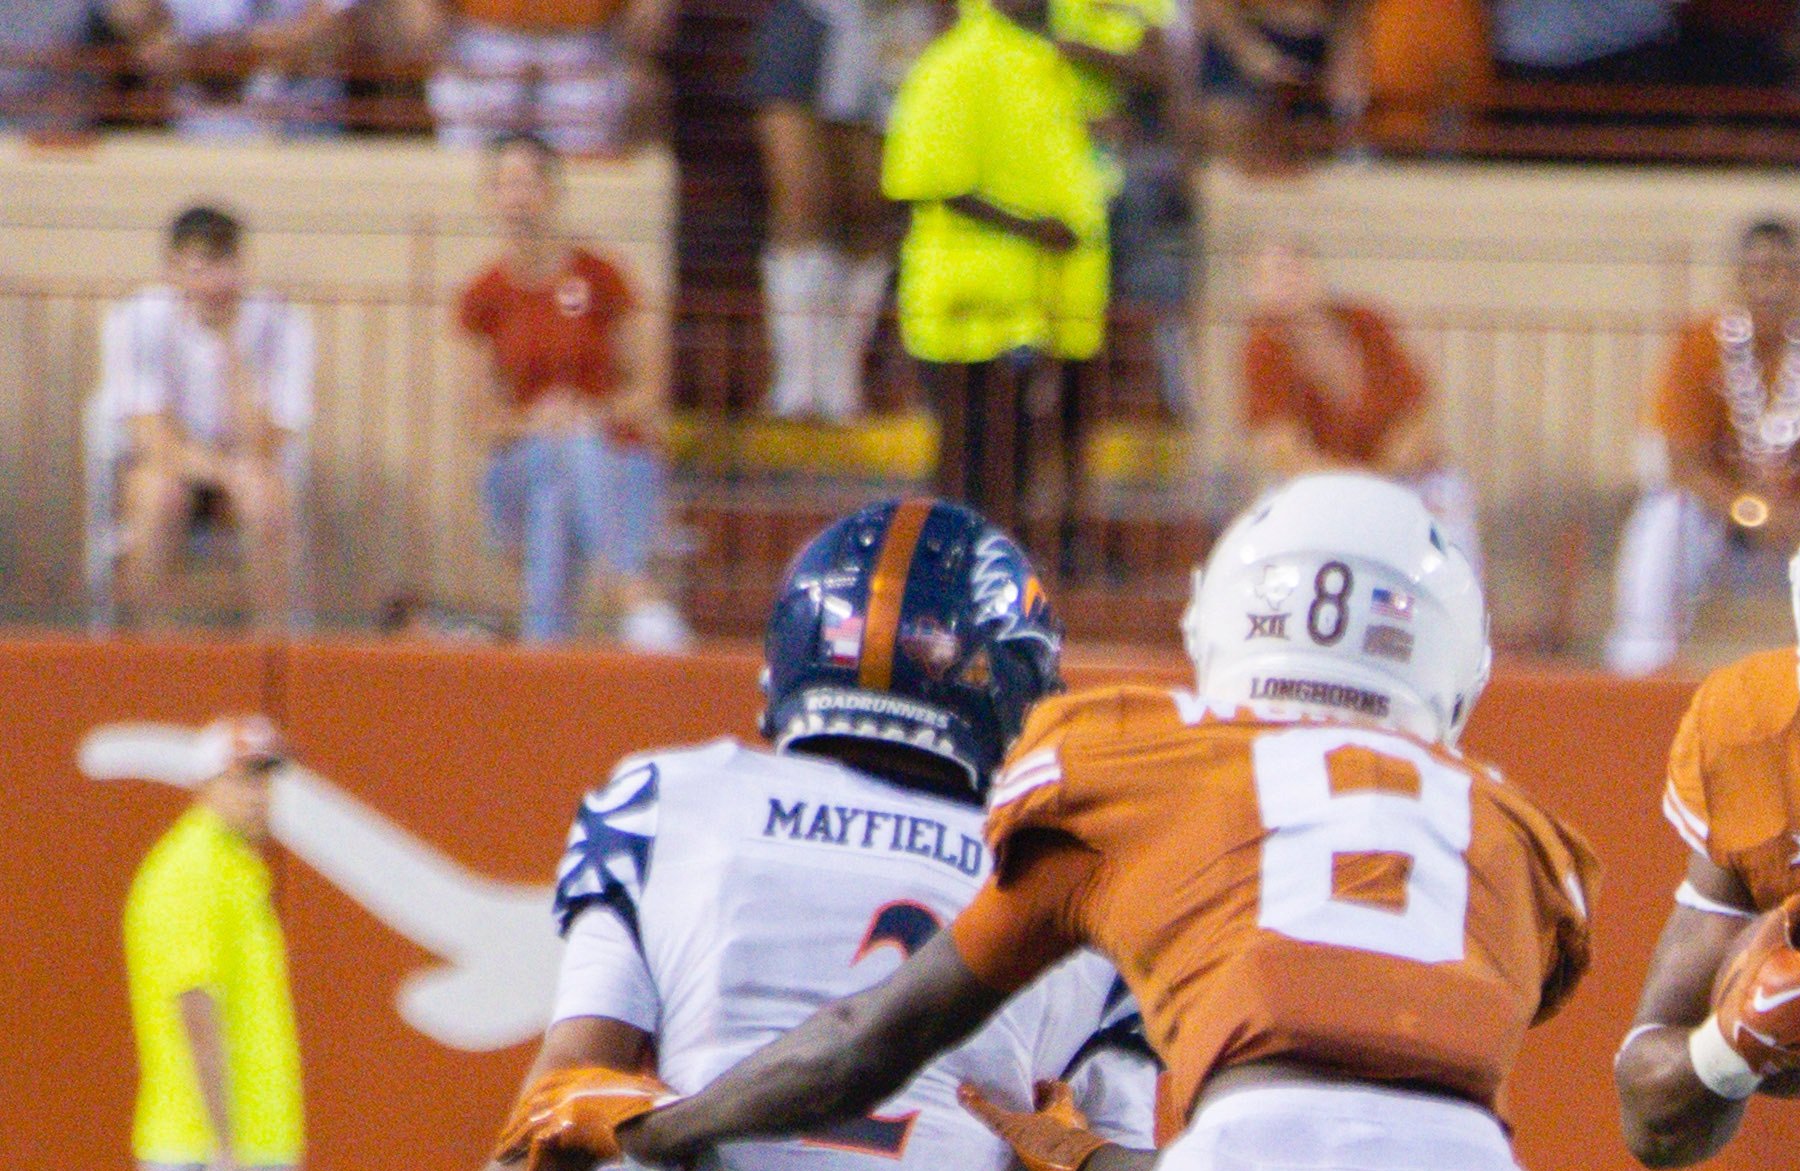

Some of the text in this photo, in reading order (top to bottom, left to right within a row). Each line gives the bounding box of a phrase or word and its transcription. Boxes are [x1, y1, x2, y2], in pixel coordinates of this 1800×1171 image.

[1306, 559, 1355, 648] 8
[1250, 676, 1392, 719] LONGHORNS
[763, 797, 983, 878] MAYFIELD
[1252, 727, 1472, 964] 8
